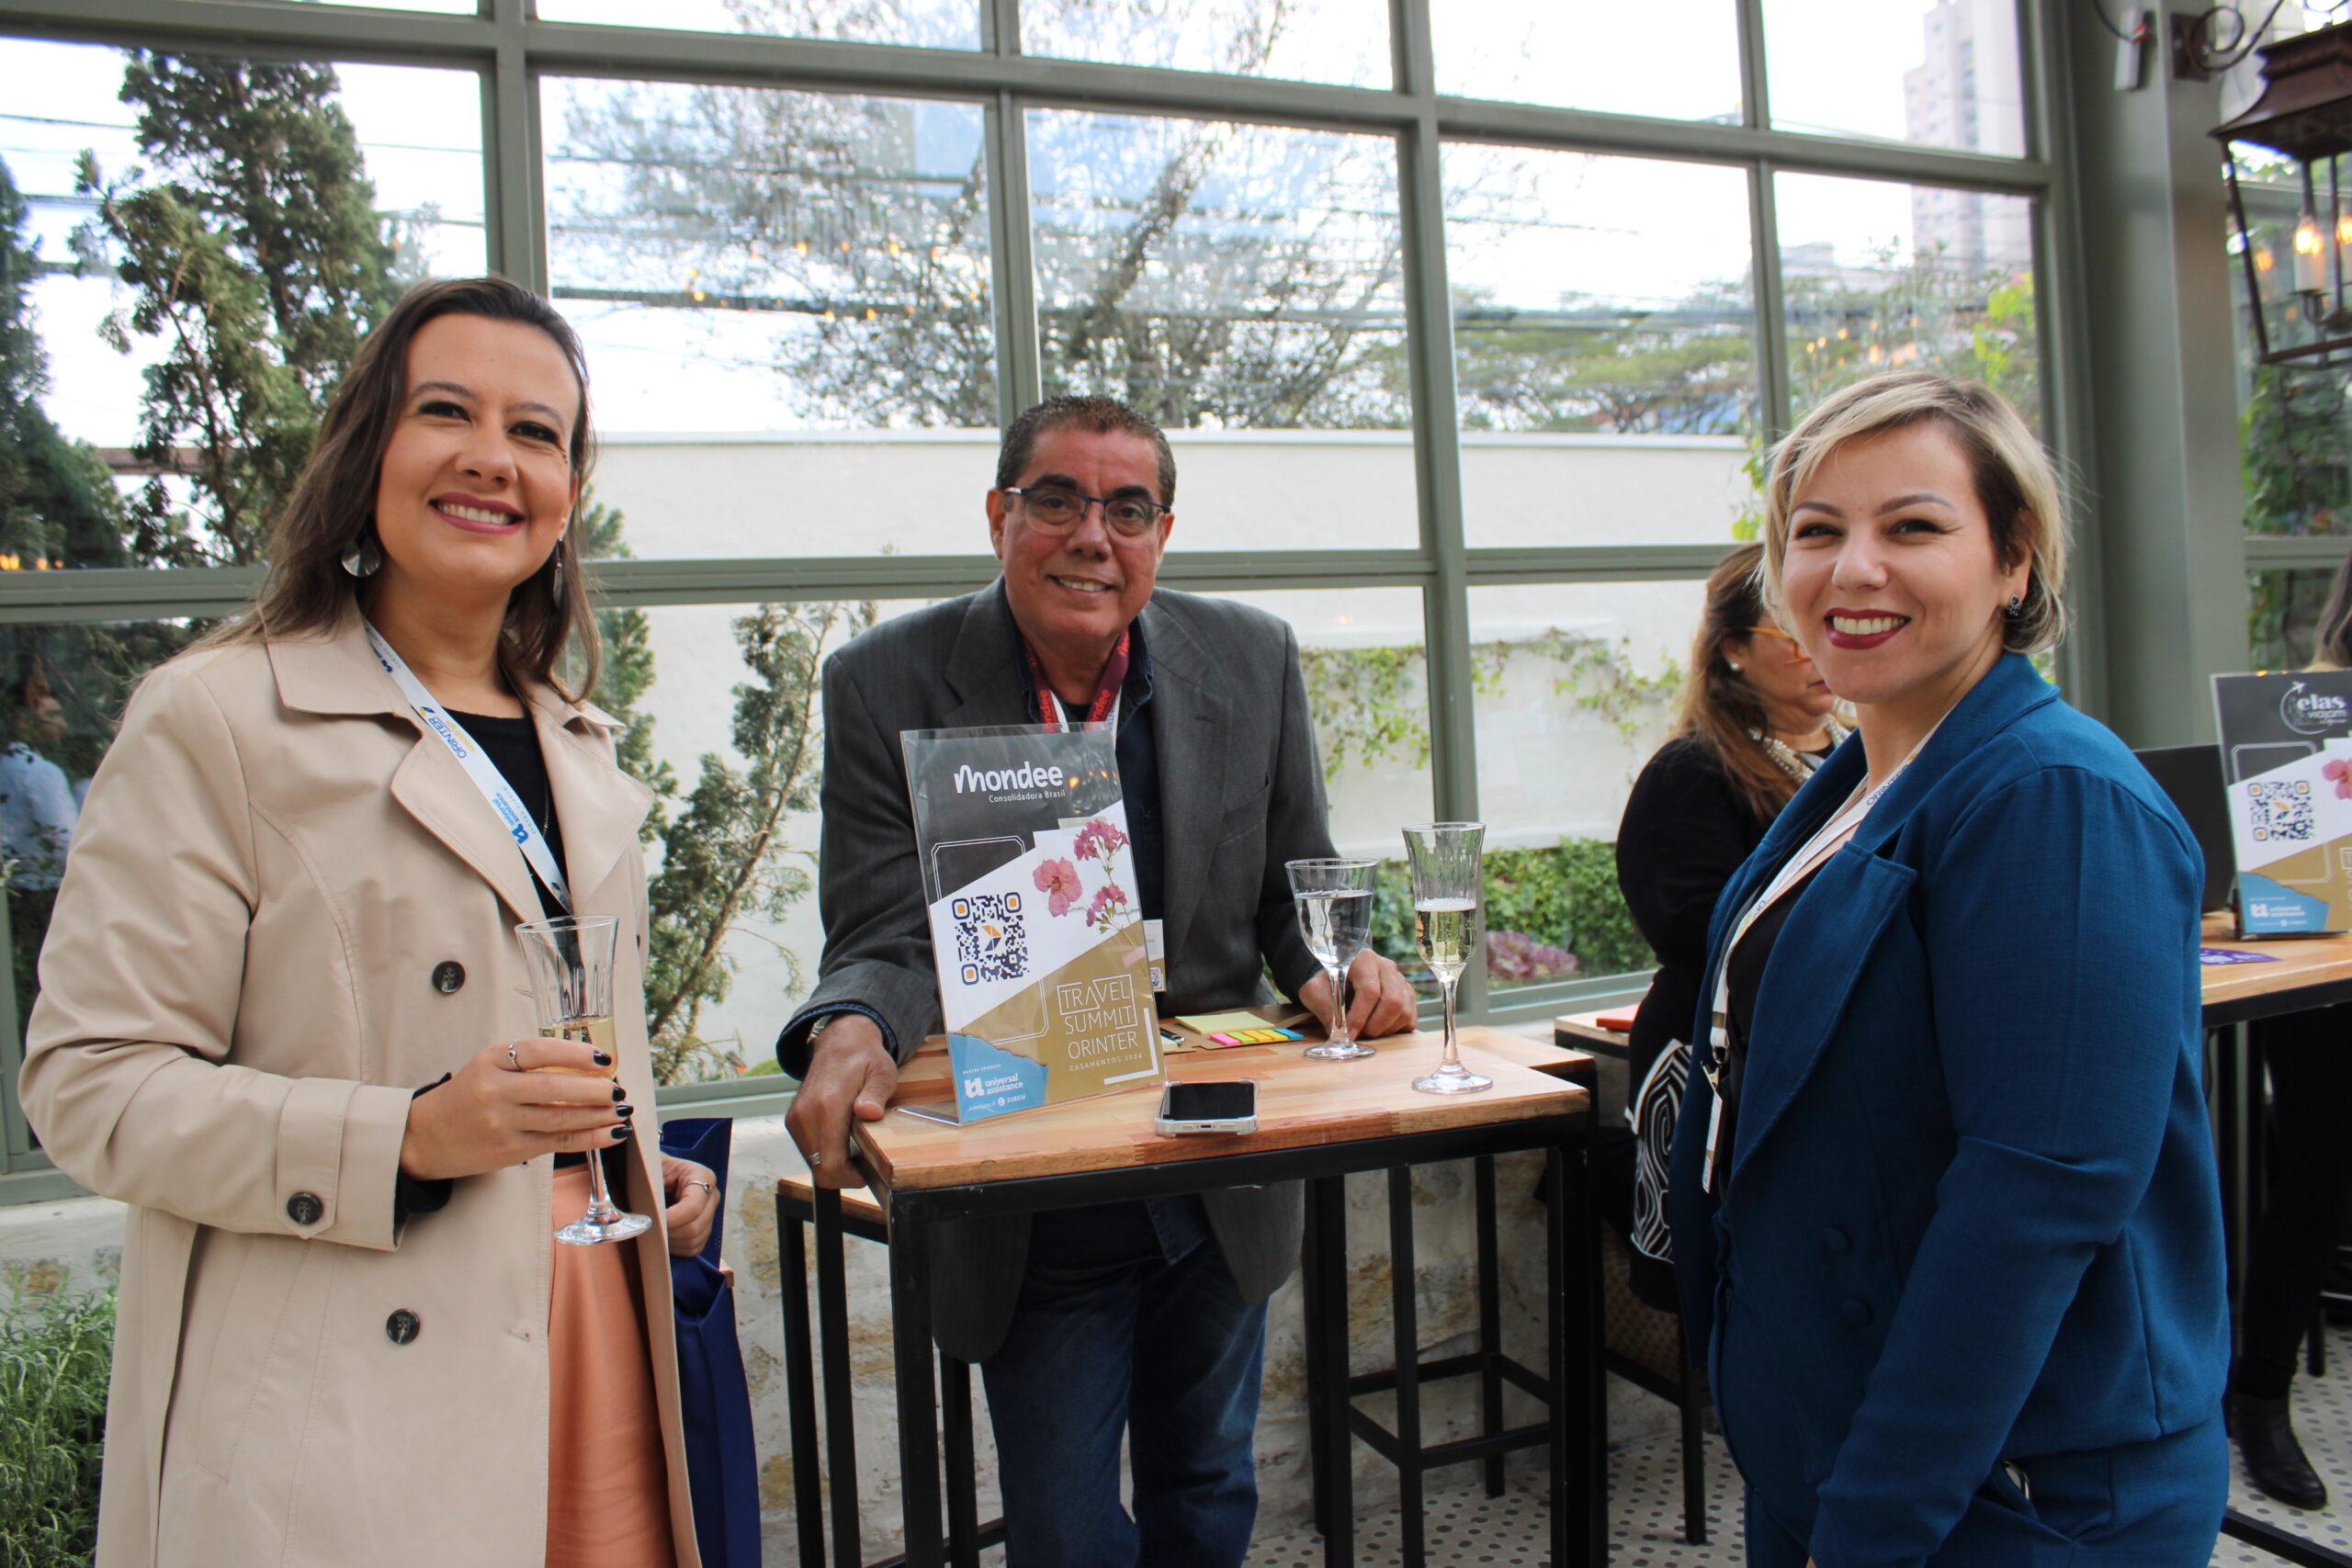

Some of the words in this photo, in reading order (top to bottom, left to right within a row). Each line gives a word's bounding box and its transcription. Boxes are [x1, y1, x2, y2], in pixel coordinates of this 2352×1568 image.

[2297, 694, 2346, 711] elas
[428, 716, 467, 758] ORINTER
[989, 792, 1043, 804] Consolidadora
[1044, 790, 1066, 799] Brasil
[1060, 980, 1131, 1010] TRAVEL
[1064, 1005, 1133, 1035] SUMMIT
[1068, 1031, 1138, 1059] ORINTER
[1069, 1055, 1121, 1072] CASAMENTOS
[985, 1072, 1019, 1088] universal
[986, 1081, 1024, 1096] assistance
